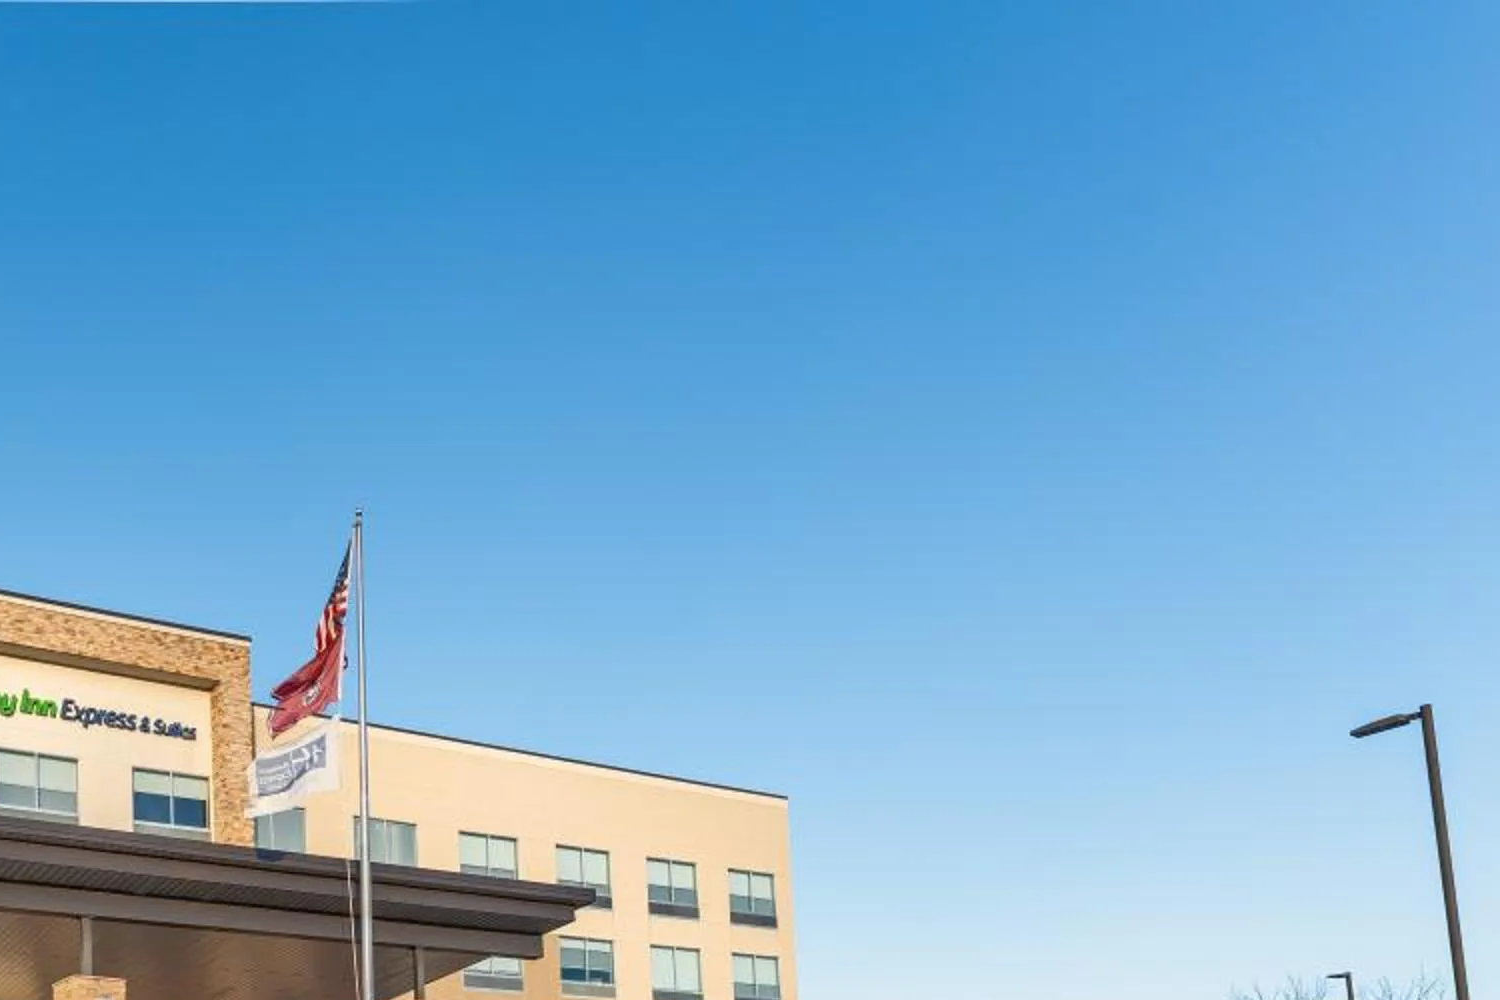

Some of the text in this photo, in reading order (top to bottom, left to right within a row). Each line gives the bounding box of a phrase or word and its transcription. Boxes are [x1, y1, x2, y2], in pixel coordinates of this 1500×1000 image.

[20, 688, 58, 718] Inn
[61, 698, 137, 730] Express
[139, 717, 151, 733] &
[153, 719, 197, 740] Suites
